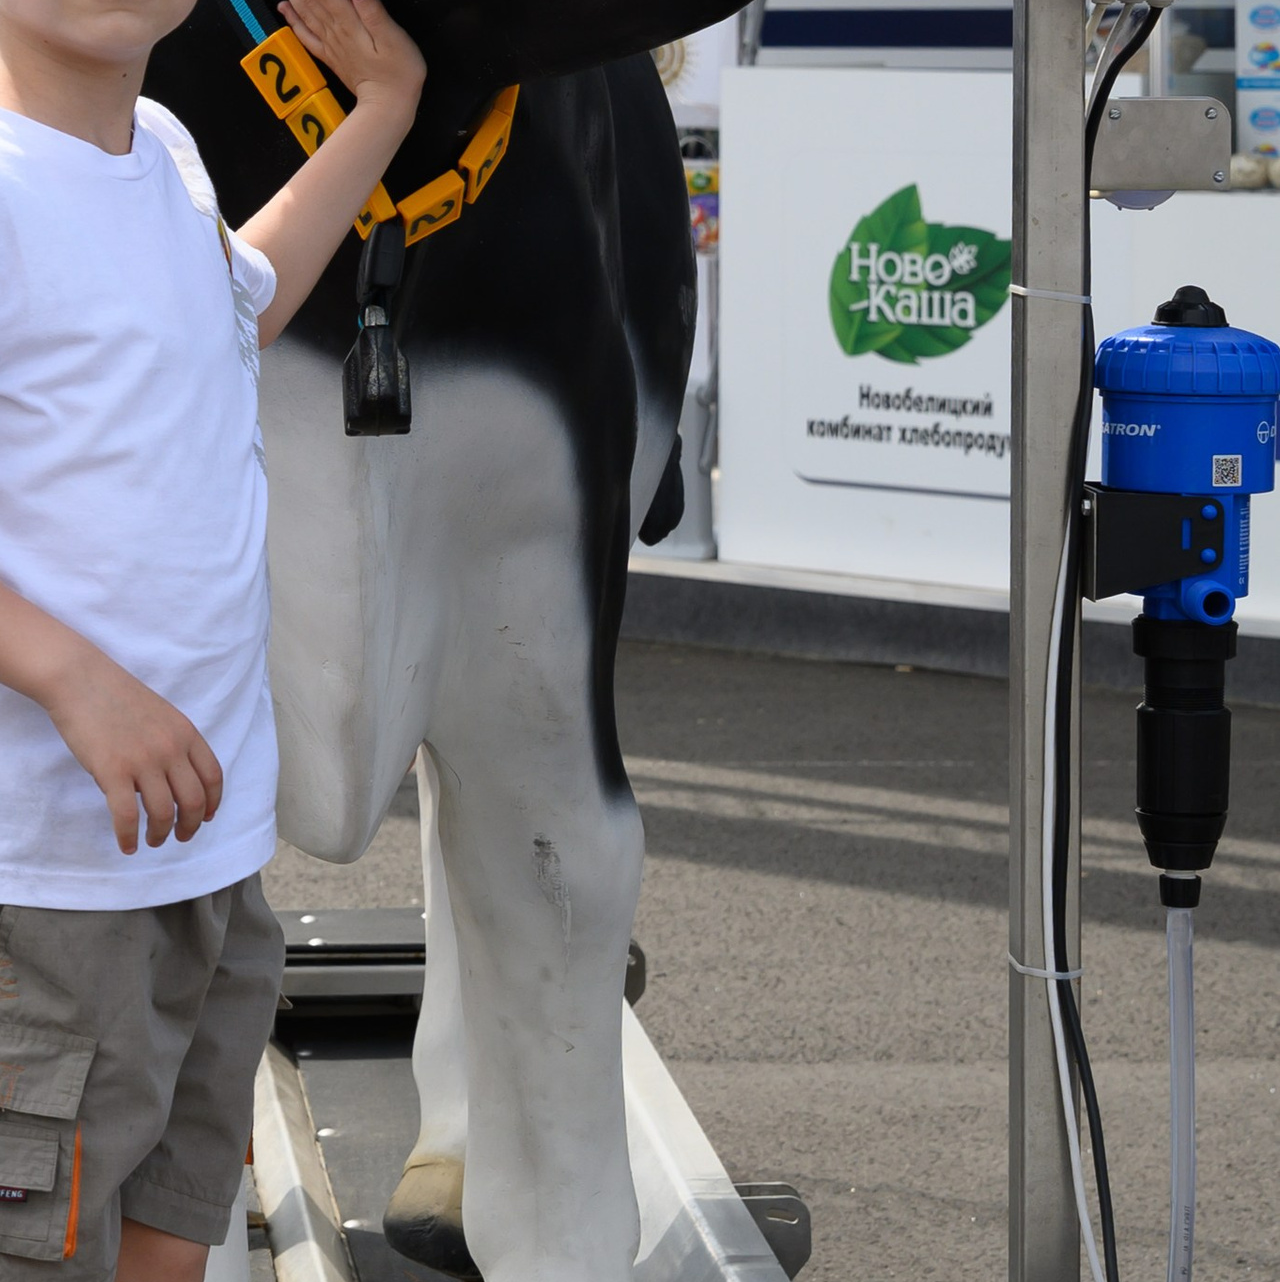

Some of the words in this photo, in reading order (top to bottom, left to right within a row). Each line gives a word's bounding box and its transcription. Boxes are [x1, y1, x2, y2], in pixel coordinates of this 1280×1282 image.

[259, 52, 301, 104] 2
[859, 384, 994, 420] Новобелицкий
[806, 415, 892, 443] комбинат
